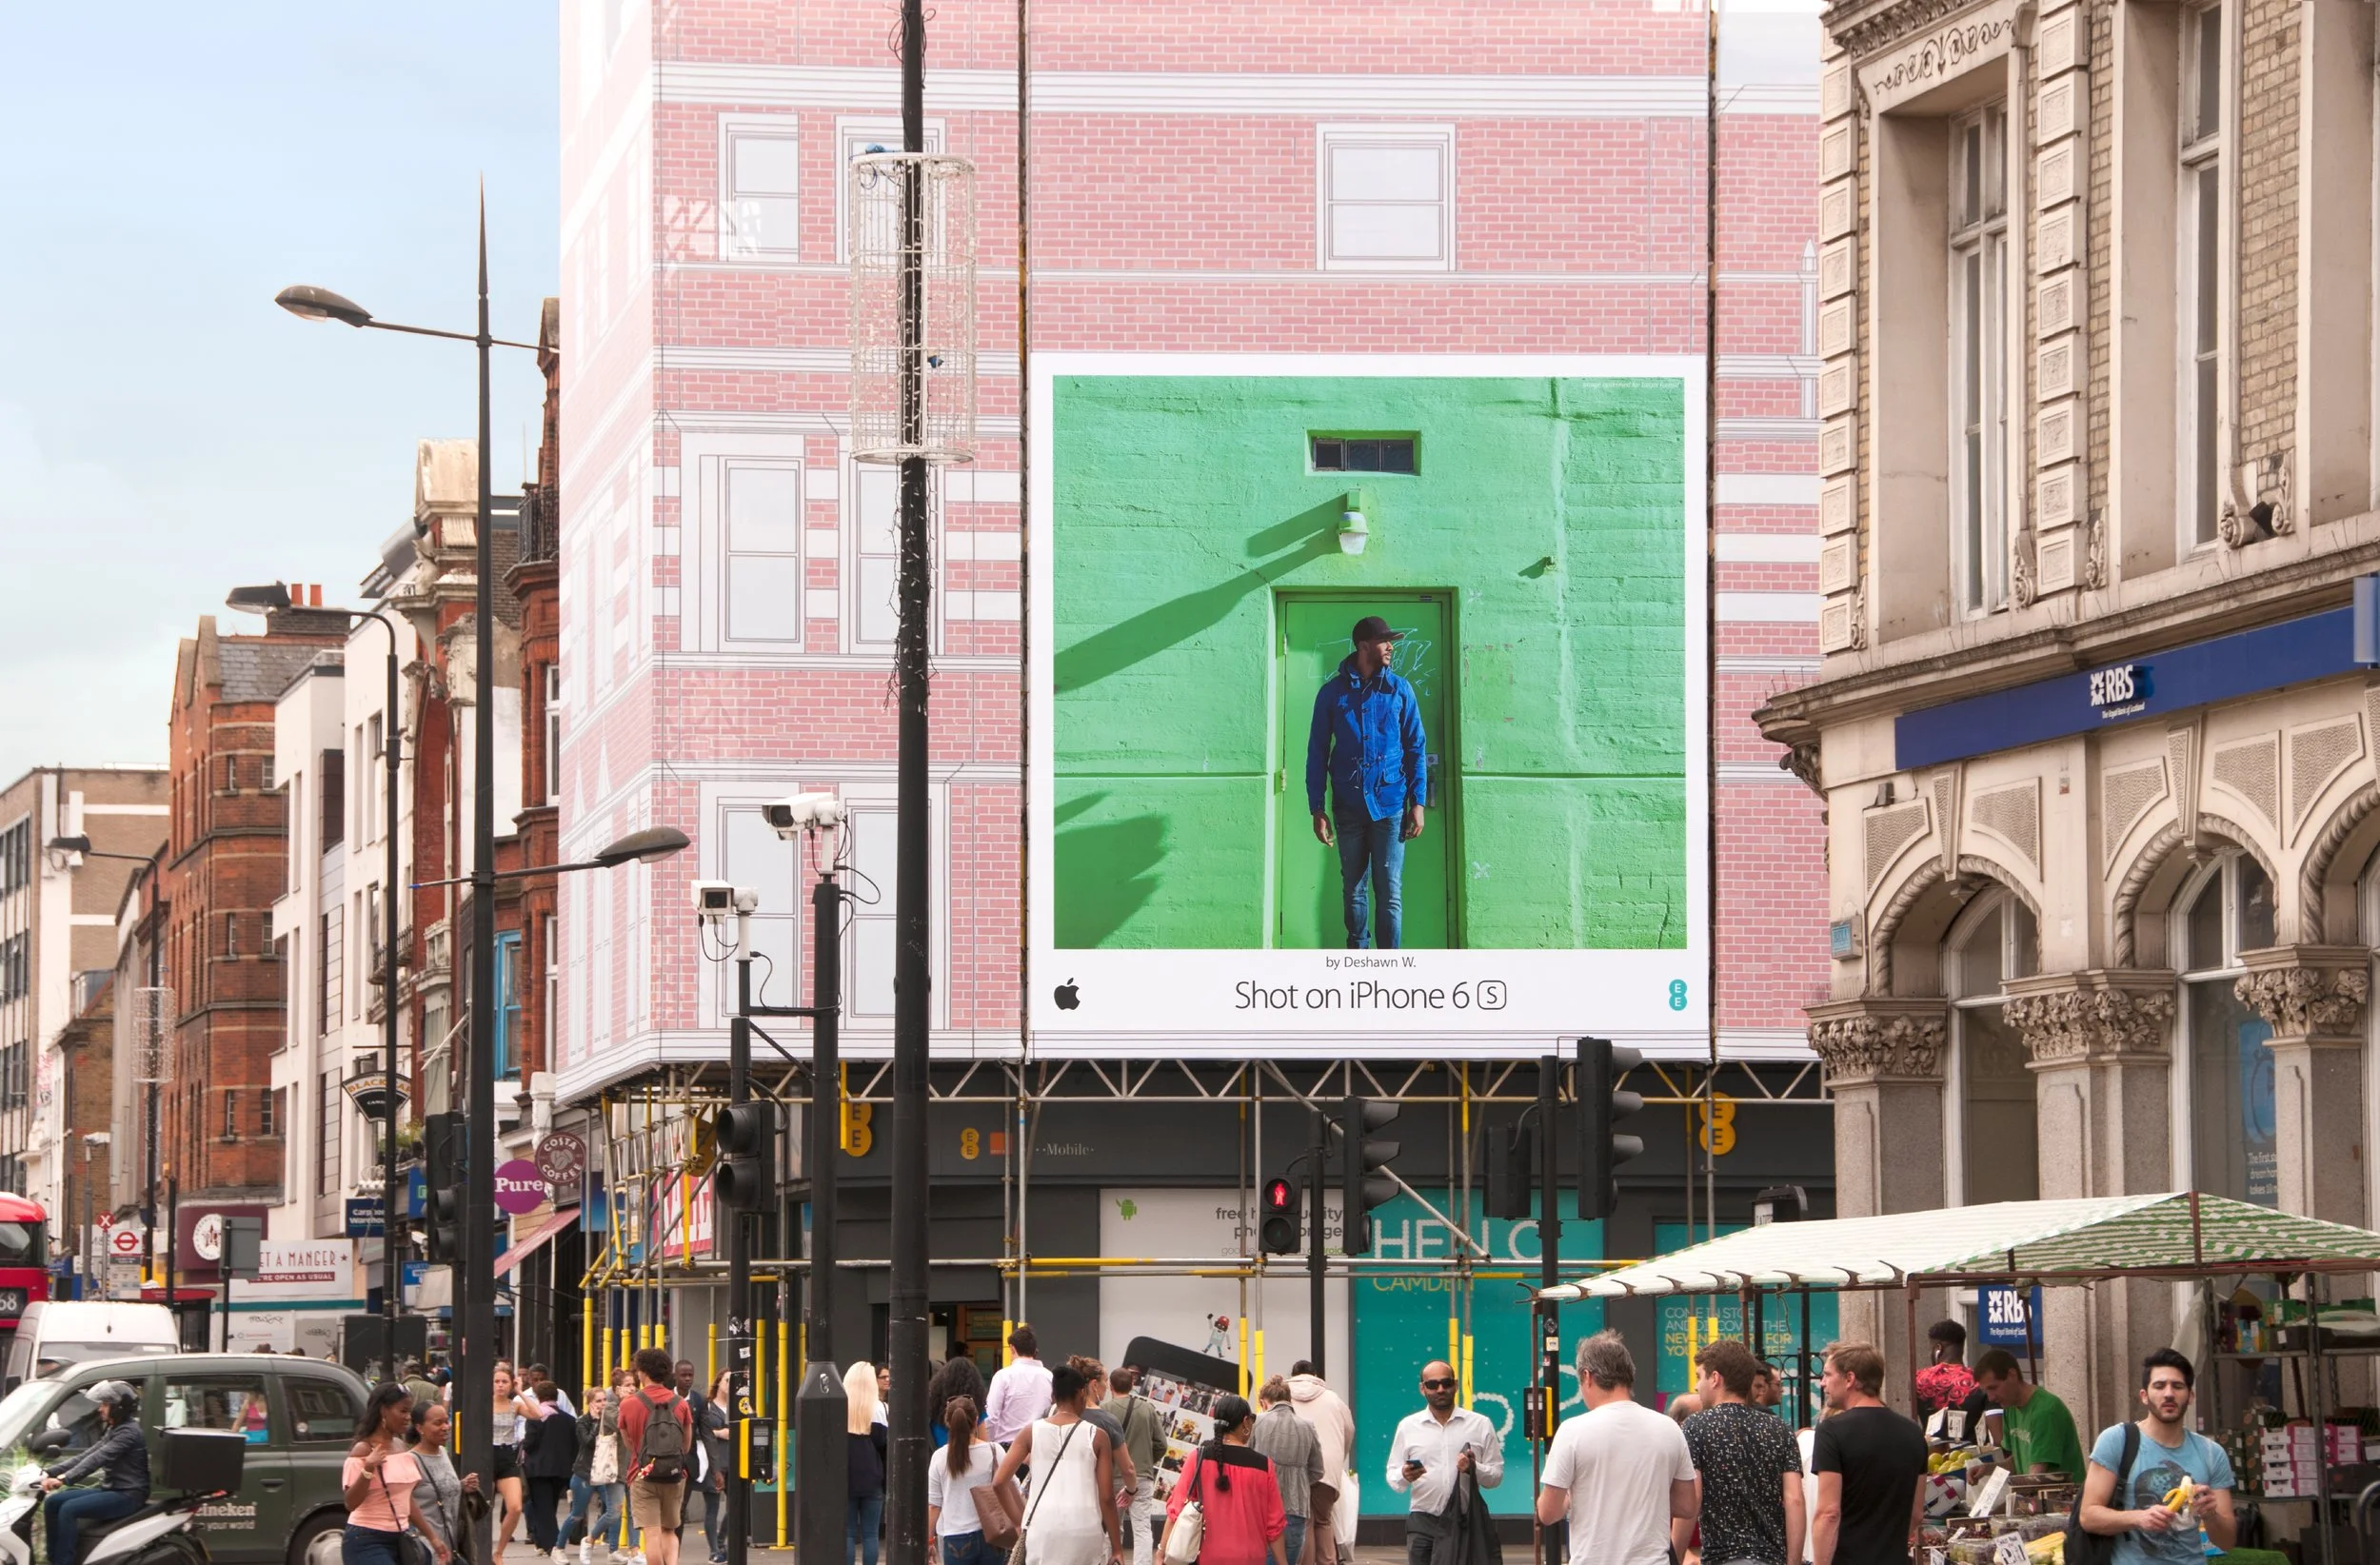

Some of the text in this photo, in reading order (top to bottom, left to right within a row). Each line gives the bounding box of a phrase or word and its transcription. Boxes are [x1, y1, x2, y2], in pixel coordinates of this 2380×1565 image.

[2105, 664, 2134, 703] RBS
[1325, 956, 1417, 970] by Deshawn W.
[1235, 981, 1299, 1009] Shot
[1305, 988, 1341, 1009] on
[1350, 981, 1445, 1009] iPhone
[1452, 981, 1470, 1009] 6
[347, 1078, 387, 1093] BLACK
[544, 1137, 577, 1153] COSTA
[1047, 1143, 1090, 1157] Mobile
[542, 1162, 583, 1180] COFFEE
[494, 1177, 545, 1193] Pure
[275, 1251, 283, 1267] A
[288, 1250, 336, 1267] MANGER
[1762, 1320, 1788, 1332] THE
[1765, 1334, 1792, 1345] FOR
